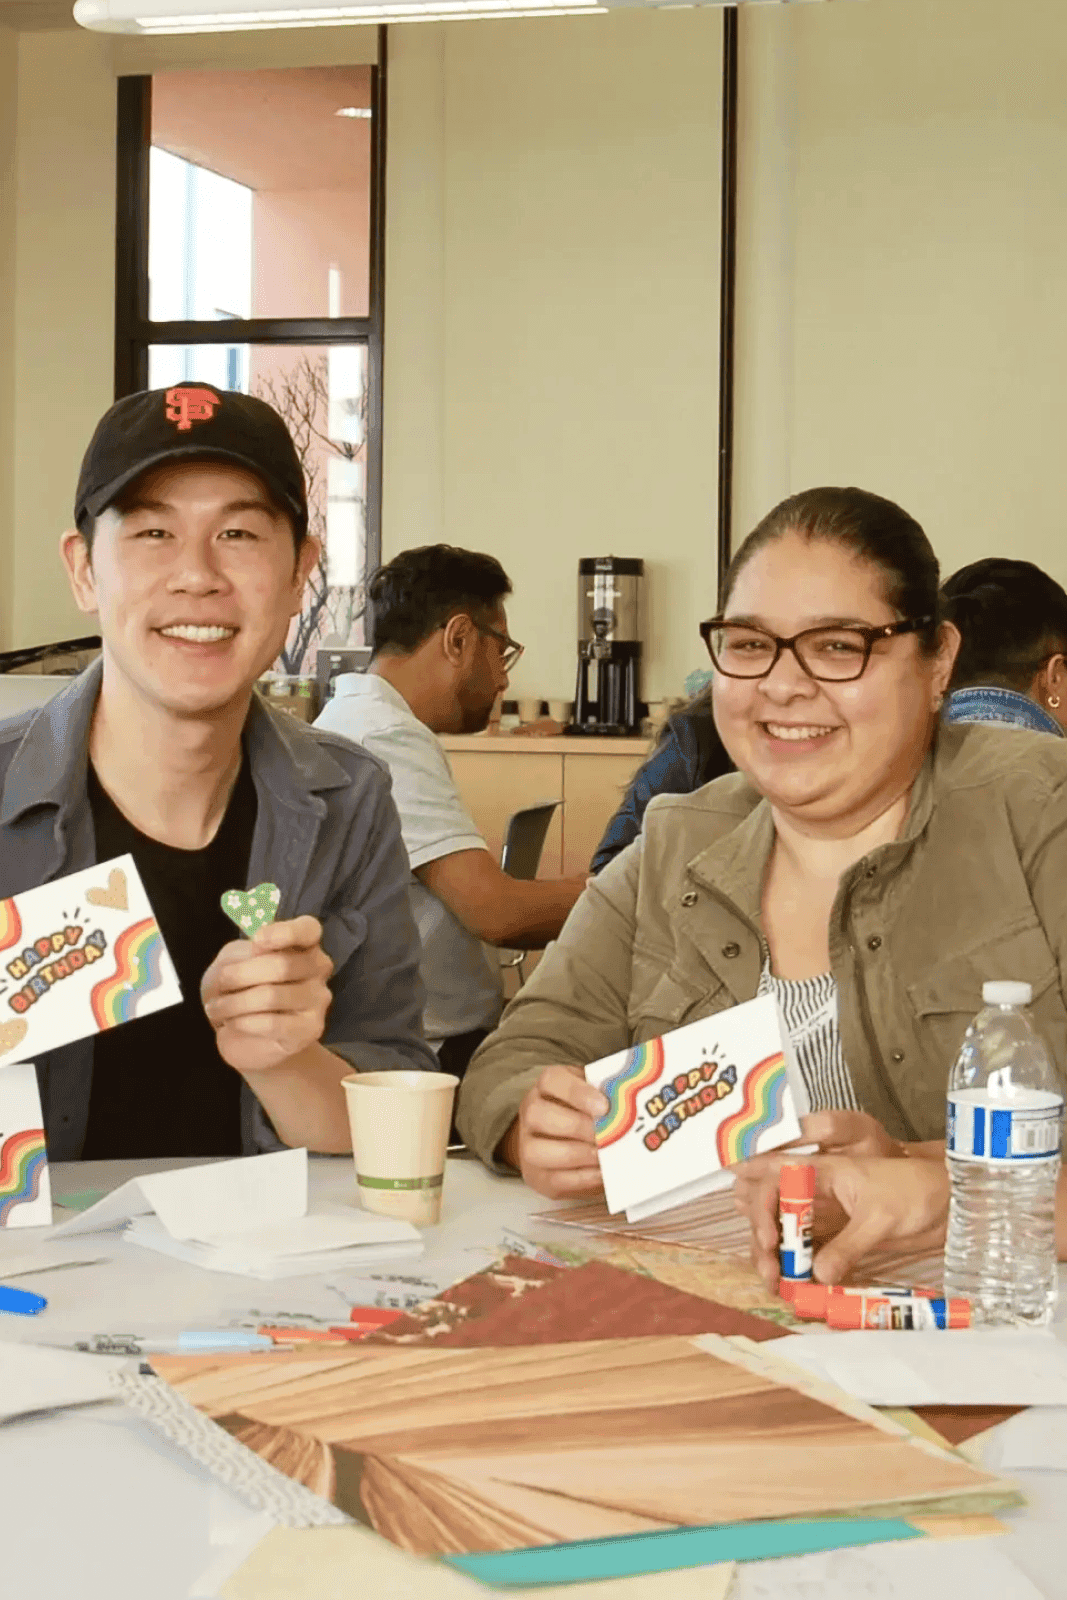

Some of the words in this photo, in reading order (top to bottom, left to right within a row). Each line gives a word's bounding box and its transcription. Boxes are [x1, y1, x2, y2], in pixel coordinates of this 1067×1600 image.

[6, 925, 84, 981] HAPPY
[8, 929, 108, 1014] BIRTHDAY
[643, 1064, 737, 1152] BIRTHDAY
[645, 1061, 718, 1118] HAPPY
